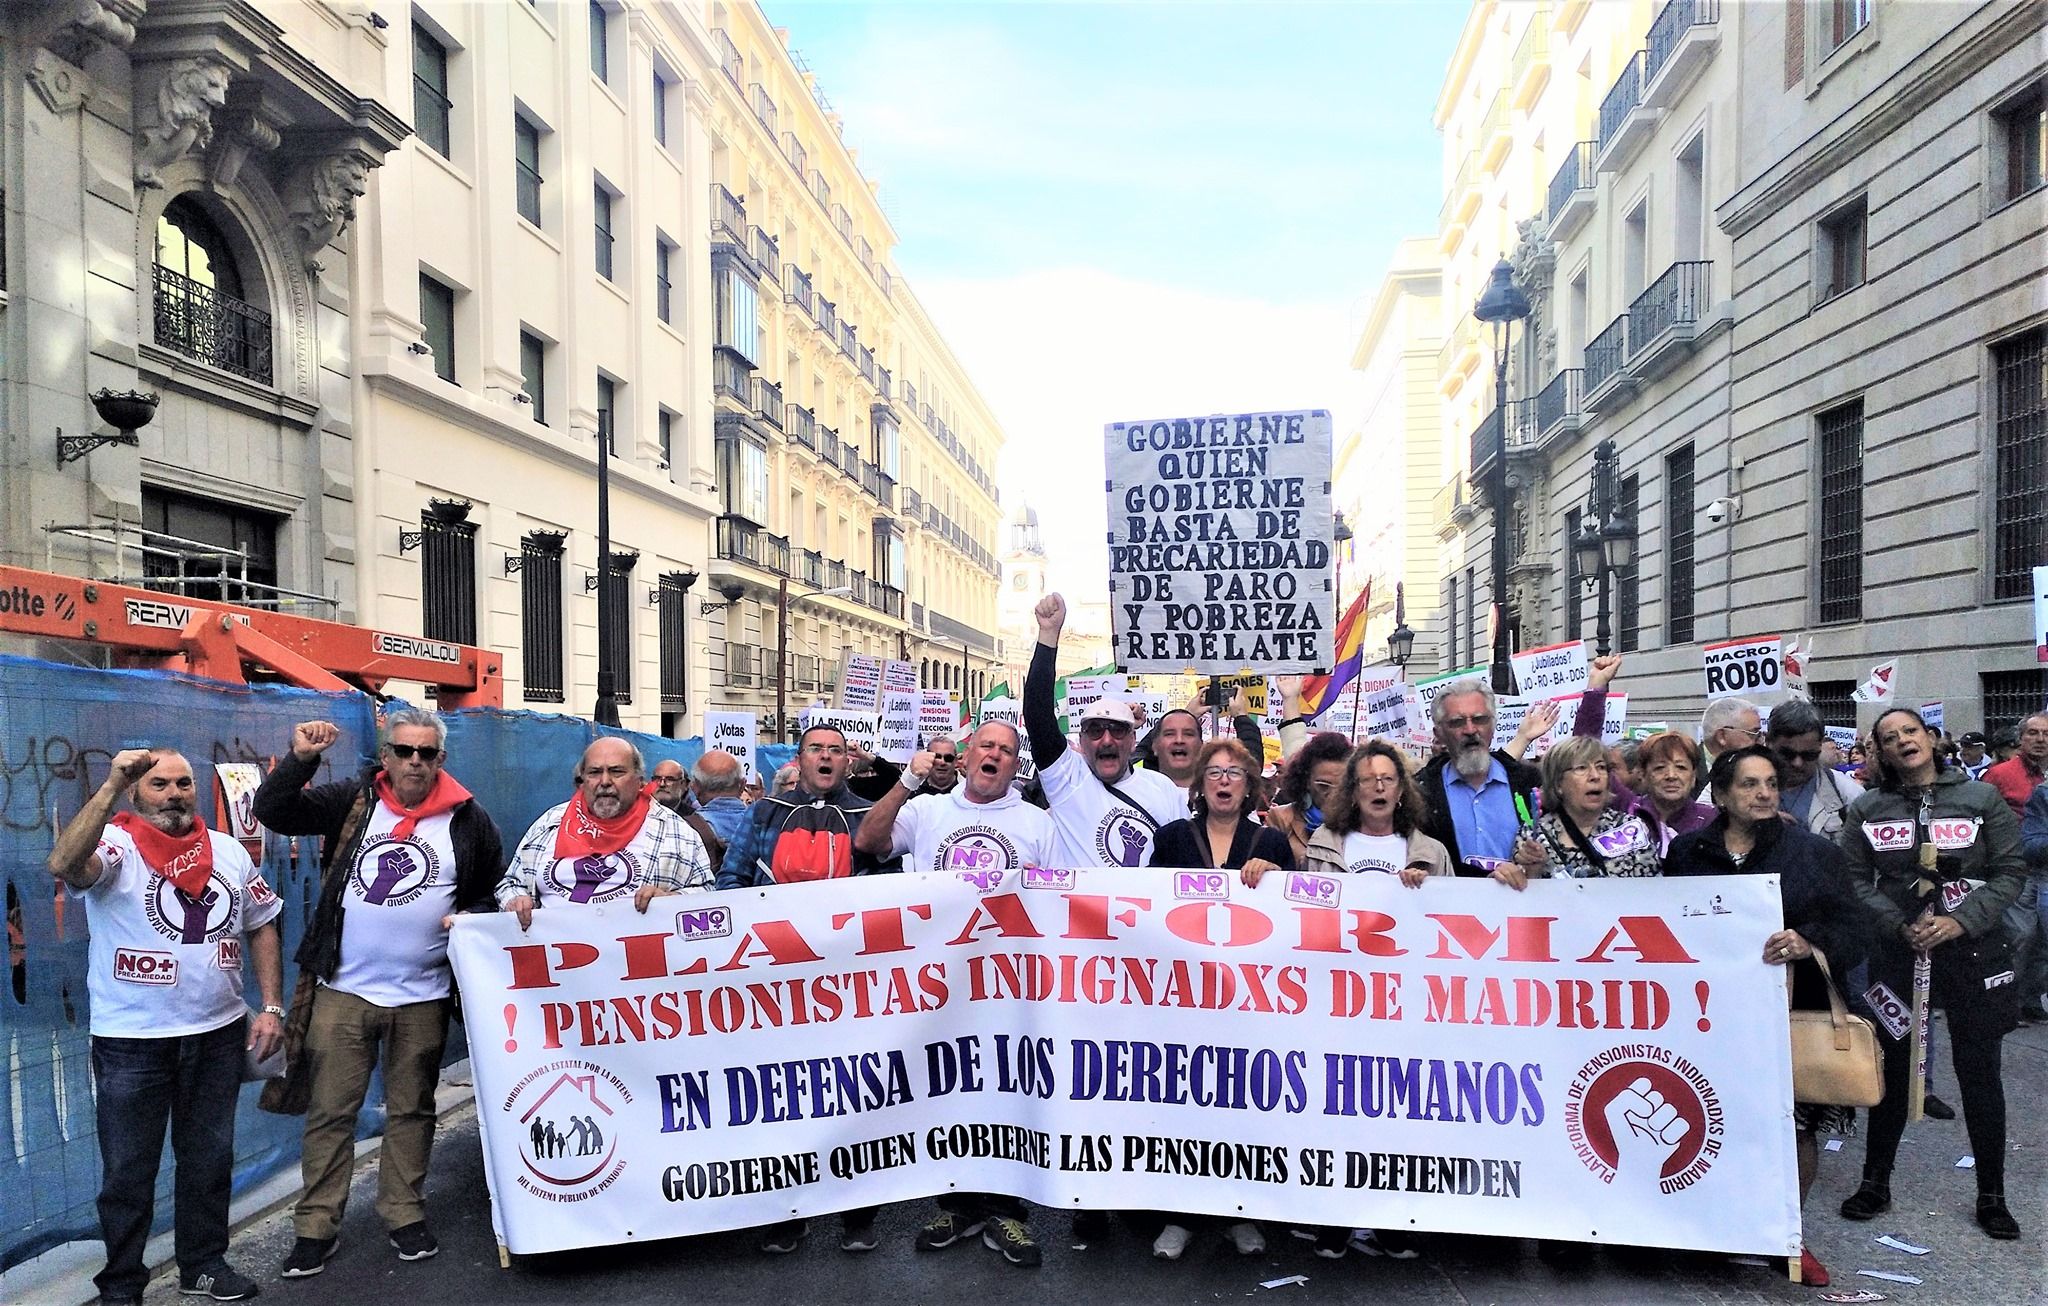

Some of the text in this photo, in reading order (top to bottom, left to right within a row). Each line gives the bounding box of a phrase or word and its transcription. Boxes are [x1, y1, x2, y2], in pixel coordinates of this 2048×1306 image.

[1127, 415, 1304, 451] GOBIERNE
[1158, 447, 1267, 480] QUIEN
[1126, 478, 1304, 513] GOBIERNE
[1127, 510, 1300, 543] BASTA DE
[1111, 540, 1328, 572] PRECARIEDAD
[1132, 572, 1296, 602] DE PARO
[1123, 602, 1322, 630] Y POBREZA
[383, 637, 458, 662] SERVIALQUI
[1531, 651, 1571, 673] ¿Jubilados?
[1705, 646, 1777, 664] MACRO-
[1706, 658, 1778, 693] ROBO
[1248, 696, 1264, 708] YA!
[714, 723, 745, 739] ¿Votas
[421, 841, 440, 884] INDIGNADXS
[939, 825, 1019, 870] DE PENSIONISTAS INDIGNADX
[1096, 826, 1116, 867] LATAFORMA
[387, 889, 422, 907] MADRID
[1289, 894, 1334, 905] PRECARIEDAD
[145, 891, 179, 941] PLATAFORMA
[208, 920, 235, 943] MADRID
[503, 893, 1700, 990] PLATAFORMA
[117, 954, 173, 974] NO+
[117, 970, 172, 981] PRECARIEDAD
[503, 953, 1711, 1053] ! PENSIONISTAS INDIGNADXS DE MADRID !
[1870, 987, 1910, 1028] NO+
[503, 1060, 633, 1112] COORDINADORA ESTATAL POR LA DEFENSA
[656, 1034, 1545, 1133] EN DEFENSA DE LOS DERECHOS HUMANOS
[1565, 1044, 1724, 1194] PLATAFORMA DE PENSIONISTAS INDIGNADXS DE MADRID
[662, 1124, 1521, 1202] GOBIERNE QUIEN GOBIERNE LAS PENSIONES SE DEFIENDEN
[517, 1159, 627, 1203] DEL SISTEMA PÚBLICO DE PENSIONES
